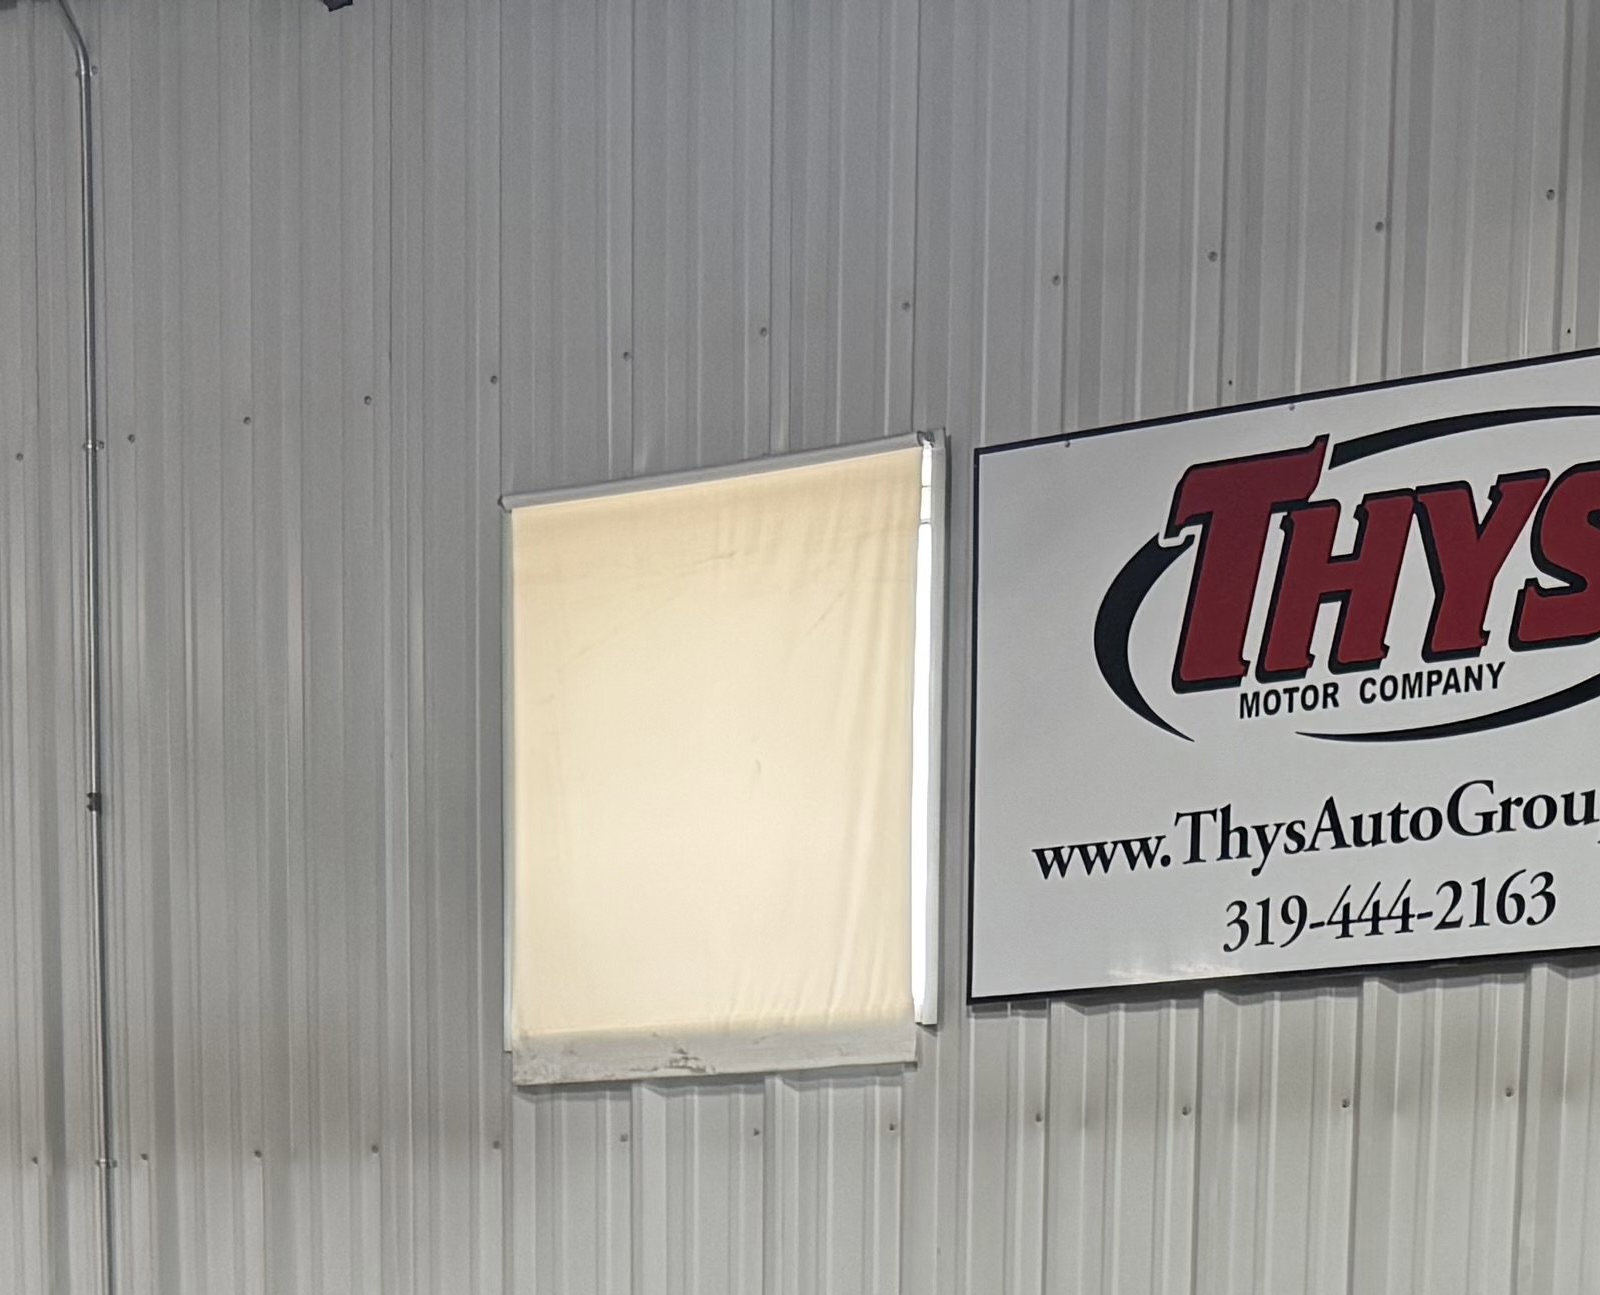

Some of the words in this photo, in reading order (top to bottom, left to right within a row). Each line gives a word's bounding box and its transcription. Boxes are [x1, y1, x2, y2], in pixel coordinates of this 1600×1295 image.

[1239, 681, 1341, 720] MOTOR
[1358, 660, 1506, 706] COMPANY
[1222, 869, 1558, 953] 319-444-2163
